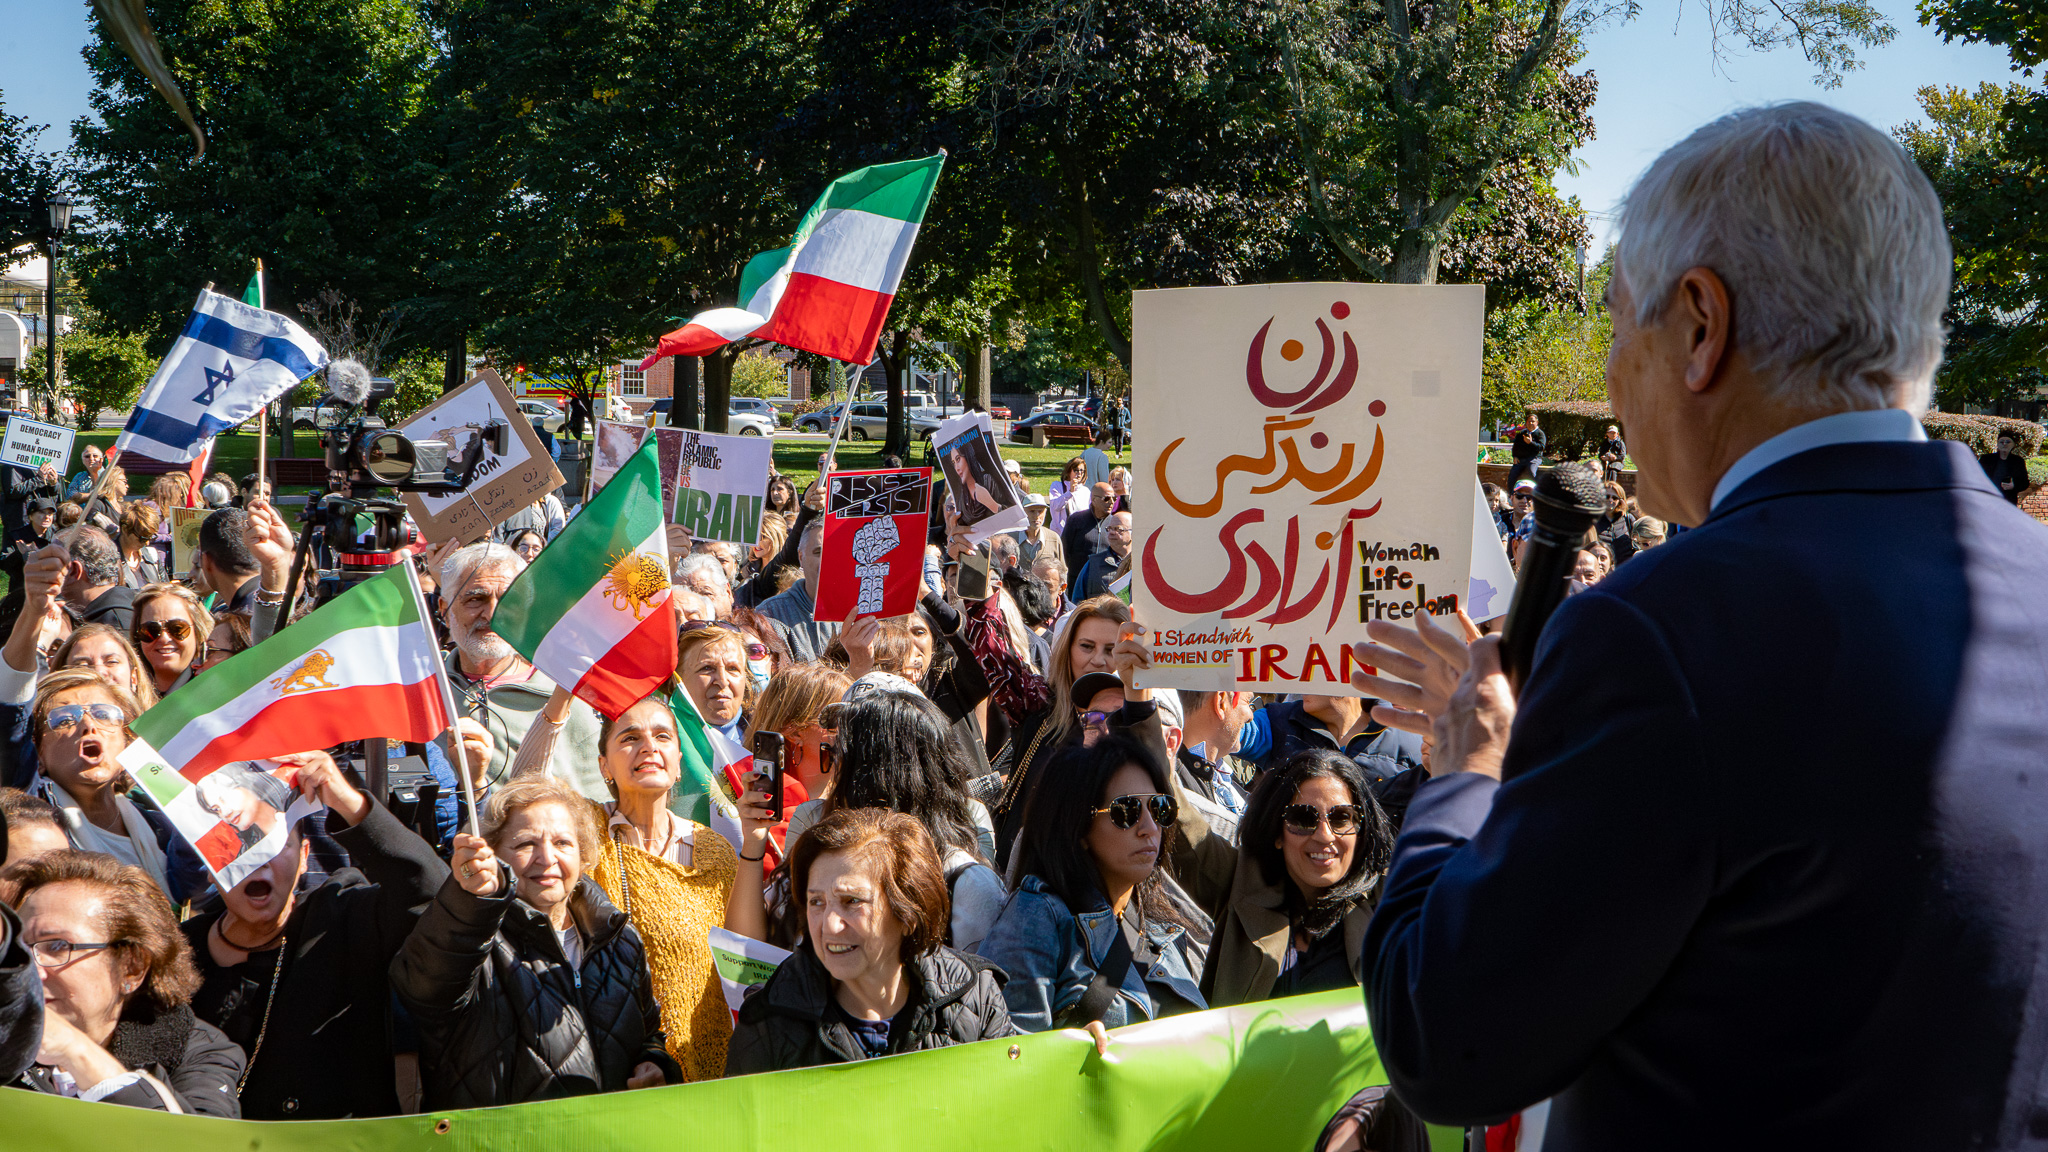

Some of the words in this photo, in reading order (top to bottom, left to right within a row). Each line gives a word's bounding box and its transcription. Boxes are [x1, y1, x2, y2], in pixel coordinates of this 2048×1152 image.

[1246, 301, 1358, 415] زن
[19, 424, 62, 440] DEMOCRACY
[685, 431, 702, 445] THE
[11, 440, 36, 454] HUMAN
[36, 446, 62, 459] RIGHTS
[16, 453, 30, 463] FOR
[684, 442, 719, 459] ISLAMIC
[1155, 399, 1386, 518] زندگی
[682, 453, 722, 470] REPUBLIC
[679, 475, 691, 488] VS
[830, 473, 920, 512] RESIST
[838, 482, 929, 517] PERSIST
[674, 486, 763, 545] IRAN
[1357, 540, 1440, 564] Woman
[1141, 497, 1382, 635] آزادی
[1360, 565, 1414, 592] Life
[1358, 584, 1458, 624] Freedom
[1153, 631, 1162, 647] I
[1211, 649, 1234, 663] OF
[721, 953, 757, 969] Support
